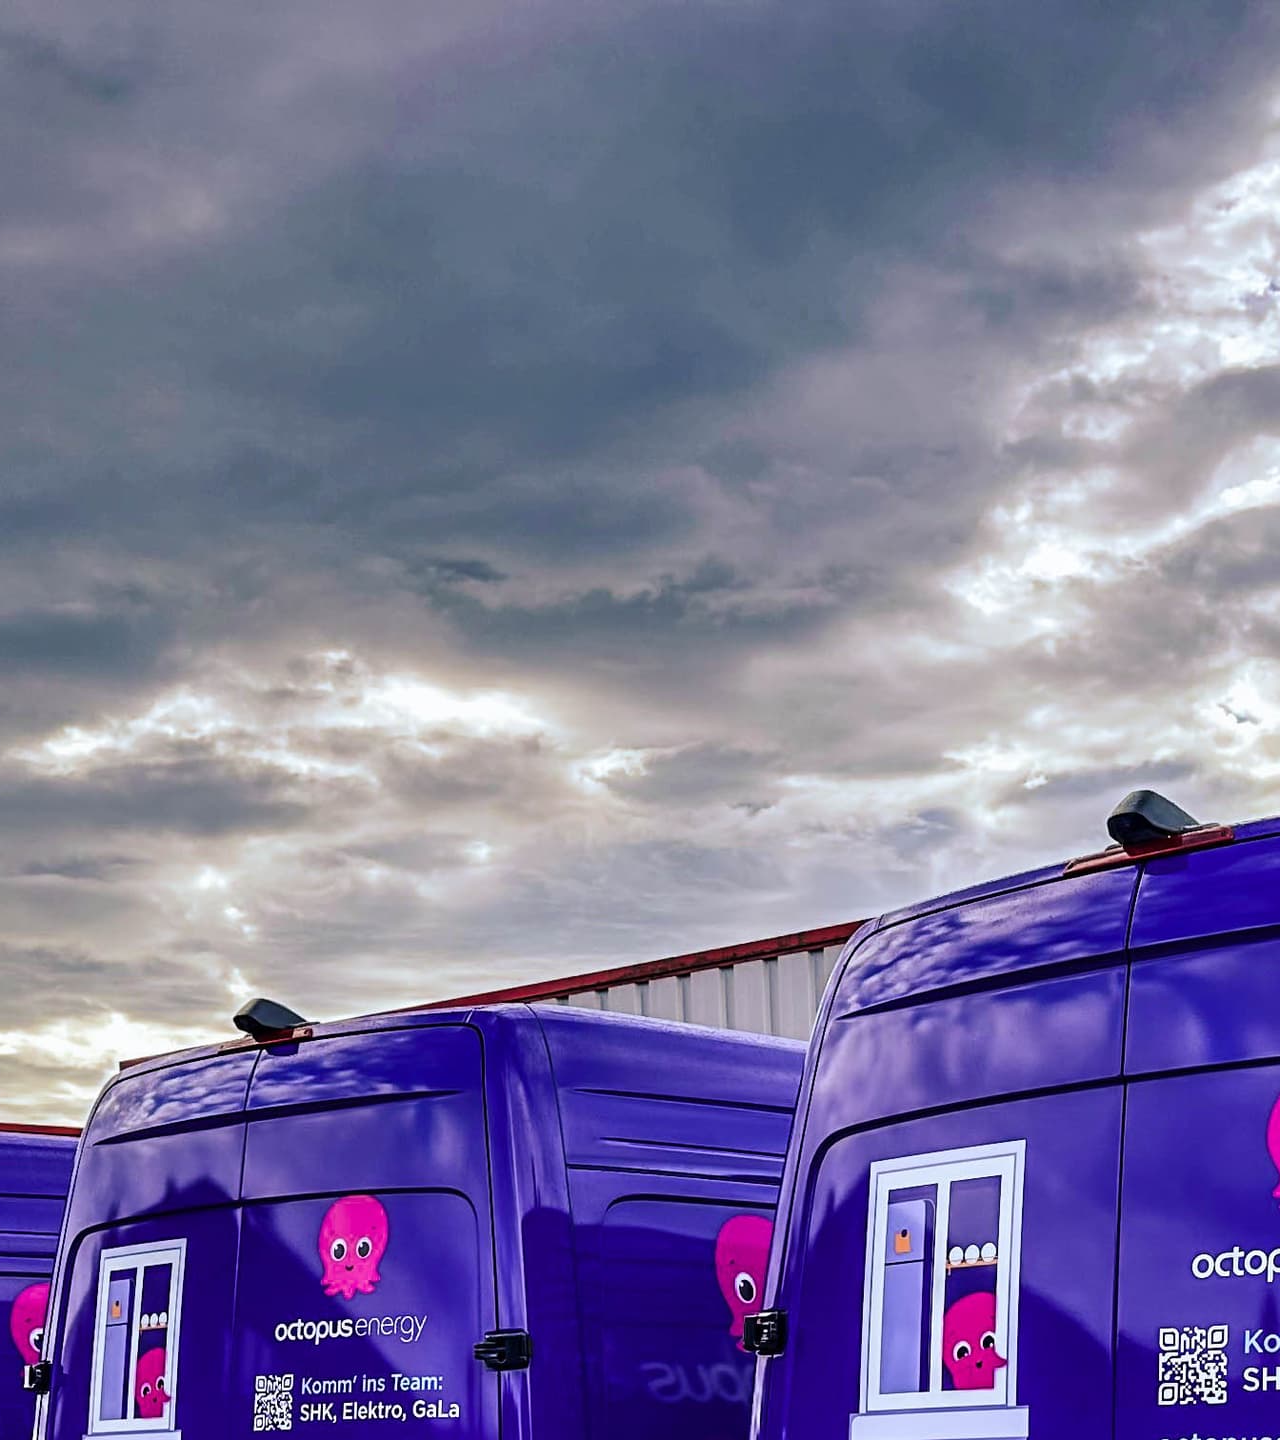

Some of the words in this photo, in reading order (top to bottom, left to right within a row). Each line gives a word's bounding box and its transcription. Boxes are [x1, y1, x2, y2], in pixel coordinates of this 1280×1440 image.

[301, 1376, 357, 1395] Komm'
[362, 1374, 386, 1393] ins
[391, 1373, 443, 1391] Team:
[299, 1403, 337, 1424] SHK,
[342, 1401, 407, 1422] Elektro,
[412, 1399, 460, 1419] GaLa
